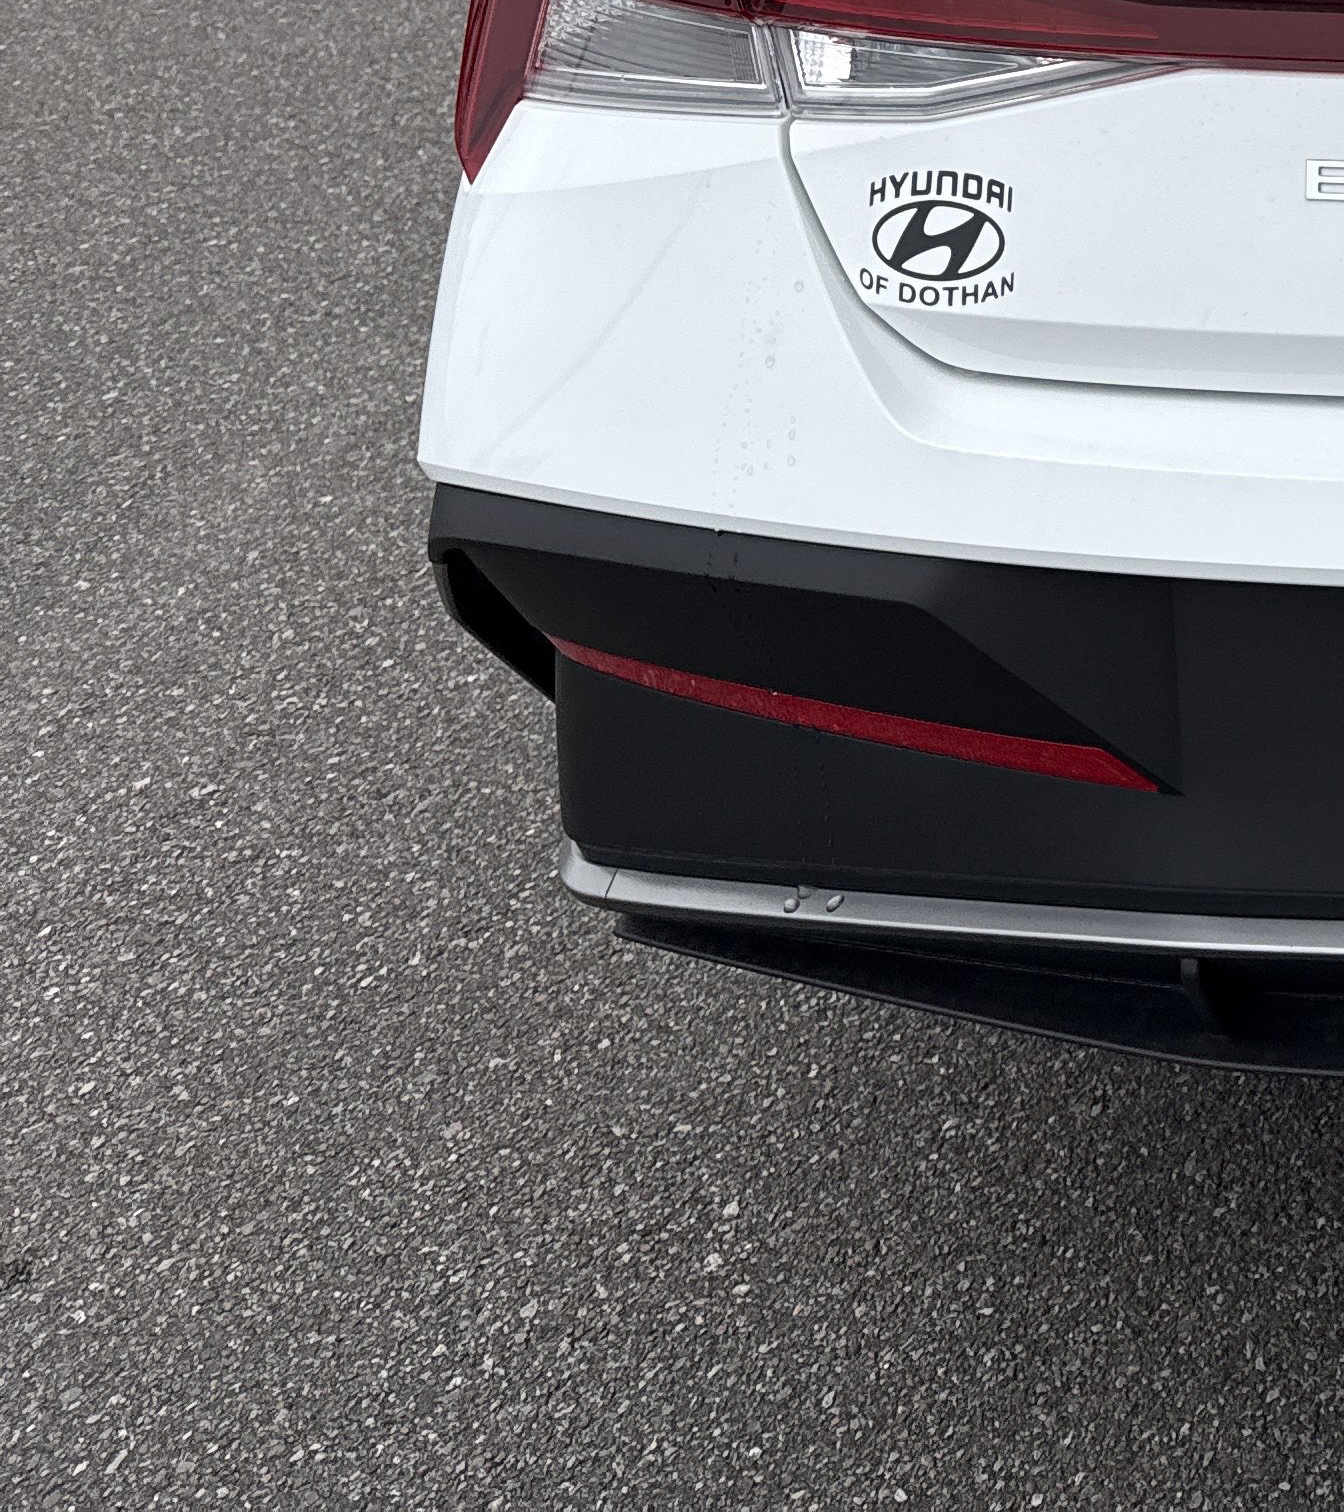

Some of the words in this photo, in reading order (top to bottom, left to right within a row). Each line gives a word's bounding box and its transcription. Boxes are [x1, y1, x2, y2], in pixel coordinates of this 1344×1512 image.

[869, 170, 1014, 212] HYUNDAI
[859, 267, 889, 296] OF
[898, 272, 1015, 307] DOTHAN
